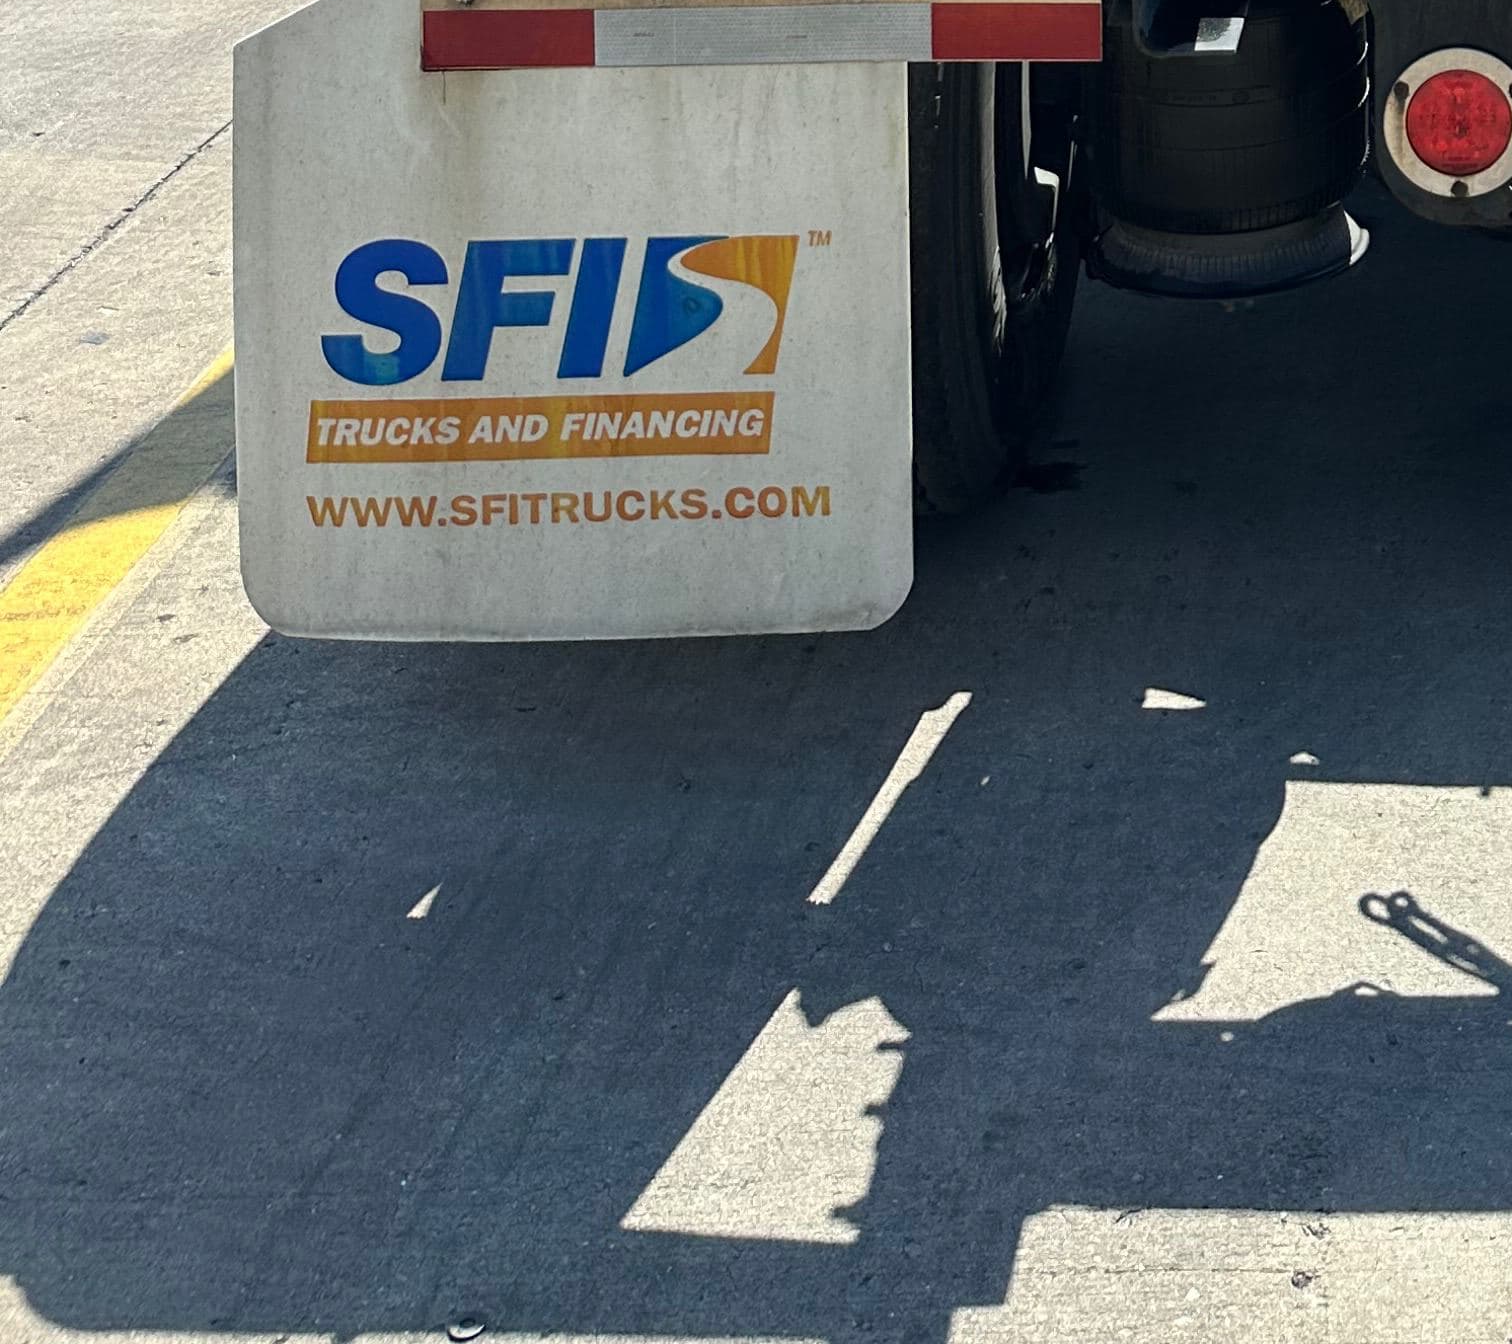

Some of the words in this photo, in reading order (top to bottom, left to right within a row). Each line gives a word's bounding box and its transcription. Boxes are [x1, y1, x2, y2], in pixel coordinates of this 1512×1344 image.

[316, 416, 460, 447] TRUCKS
[468, 413, 549, 444] AND
[560, 408, 765, 442] FINANCING
[306, 485, 832, 528] WWW.SFITRUCKS.COM
